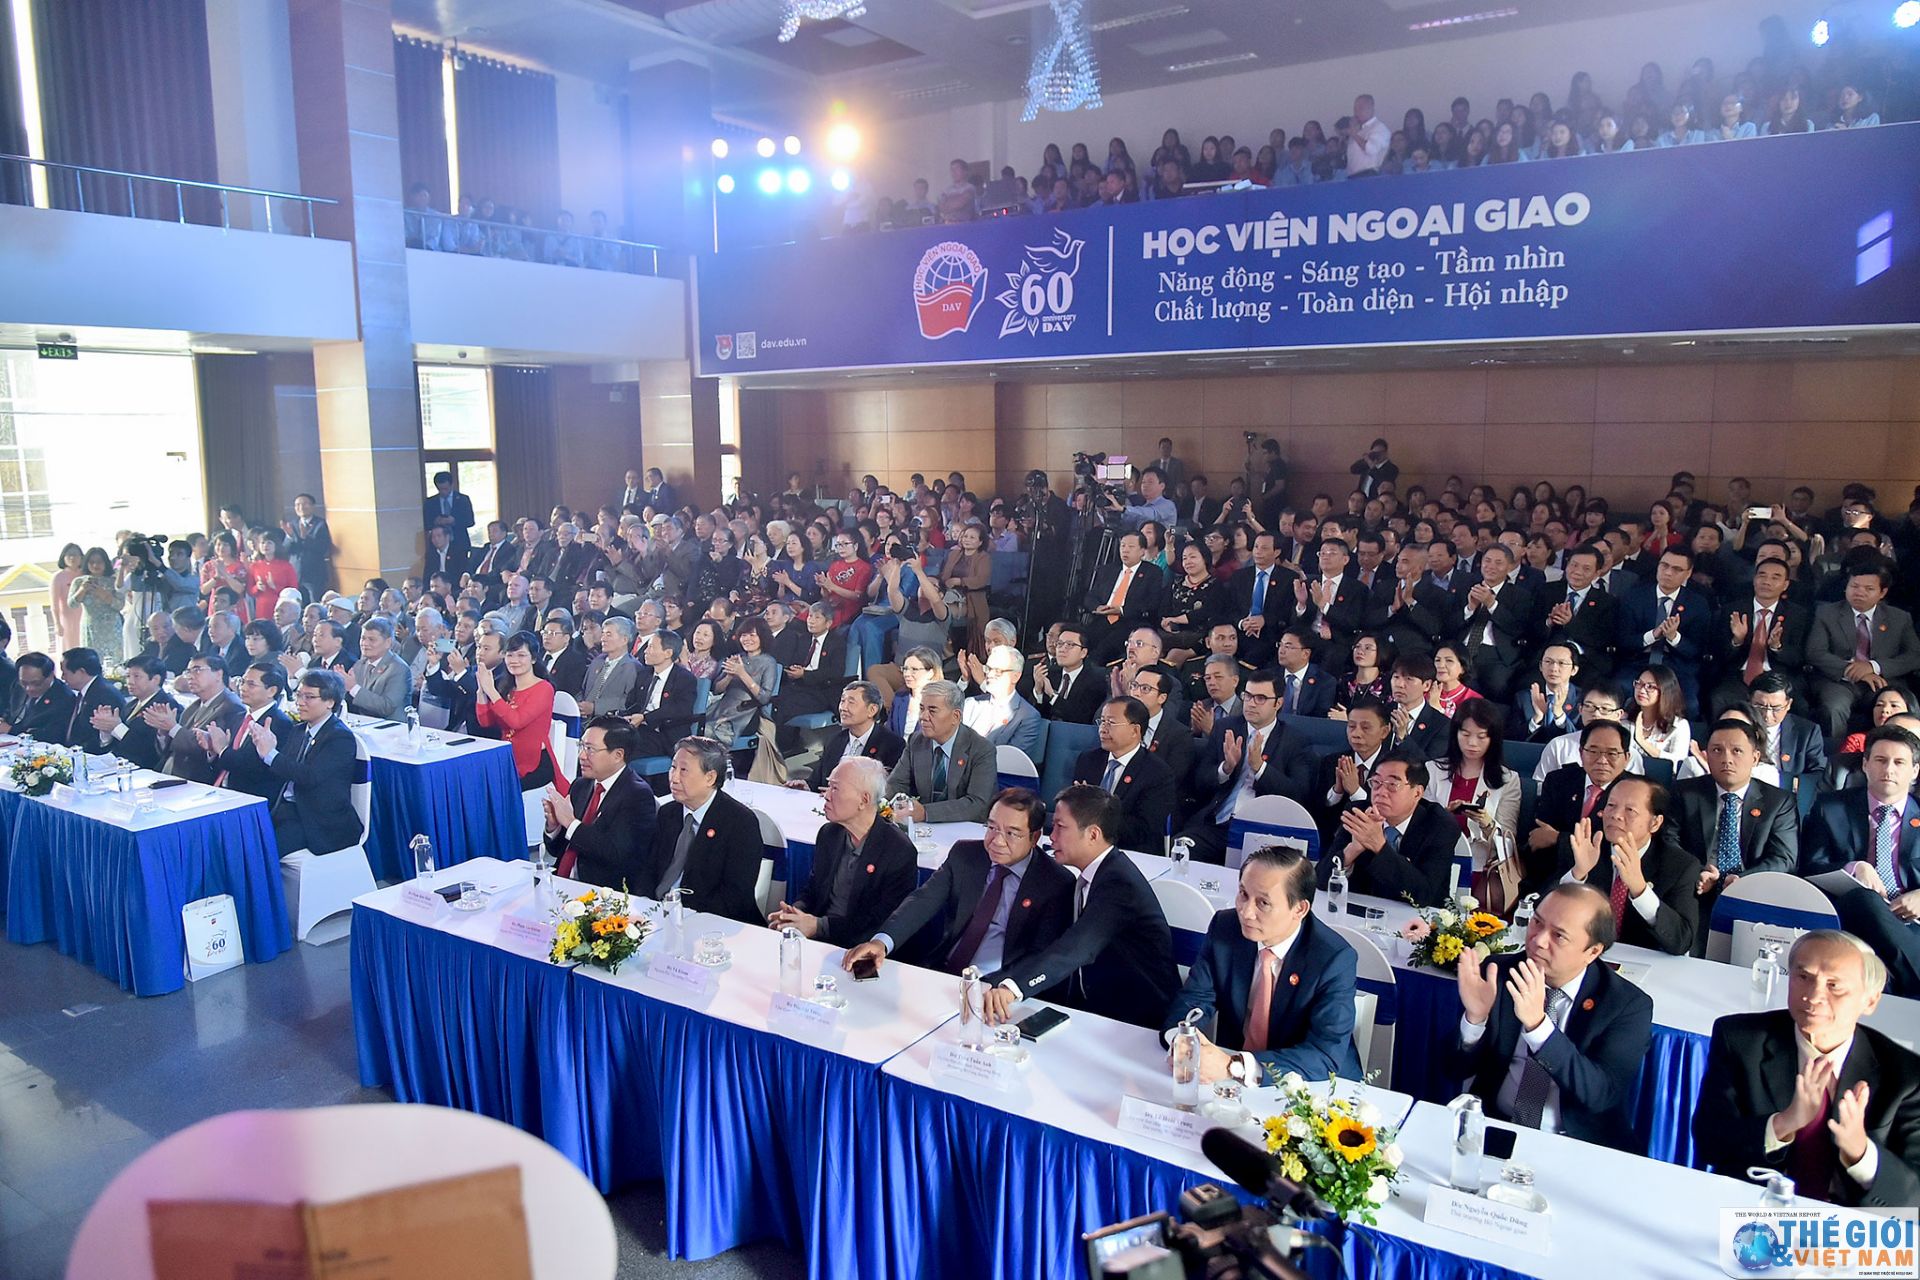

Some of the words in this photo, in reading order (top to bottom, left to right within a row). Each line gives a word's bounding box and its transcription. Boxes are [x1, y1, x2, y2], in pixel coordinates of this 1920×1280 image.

[1142, 225, 1221, 266] HỌC
[1225, 211, 1318, 258] VIỆN
[1328, 203, 1465, 246] NGOẠI
[1474, 191, 1591, 232] GIAO
[1158, 271, 1214, 296] Năng
[1221, 266, 1275, 292] động
[1301, 260, 1360, 287] Sáng
[1367, 260, 1406, 284] tạo
[1435, 245, 1496, 275] Tầm
[1504, 244, 1566, 271] nhìn
[942, 302, 962, 312] DAV
[1021, 271, 1073, 316] 60
[1154, 296, 1204, 322] Chất
[1211, 297, 1272, 323] lượng
[1298, 291, 1355, 315] Toàn
[1362, 287, 1415, 315] diện
[1444, 280, 1491, 311] Hội
[1500, 278, 1568, 309] nhập
[1042, 321, 1073, 333] DAV
[760, 337, 807, 349] dav.edu.vn
[211, 938, 226, 950] 60
